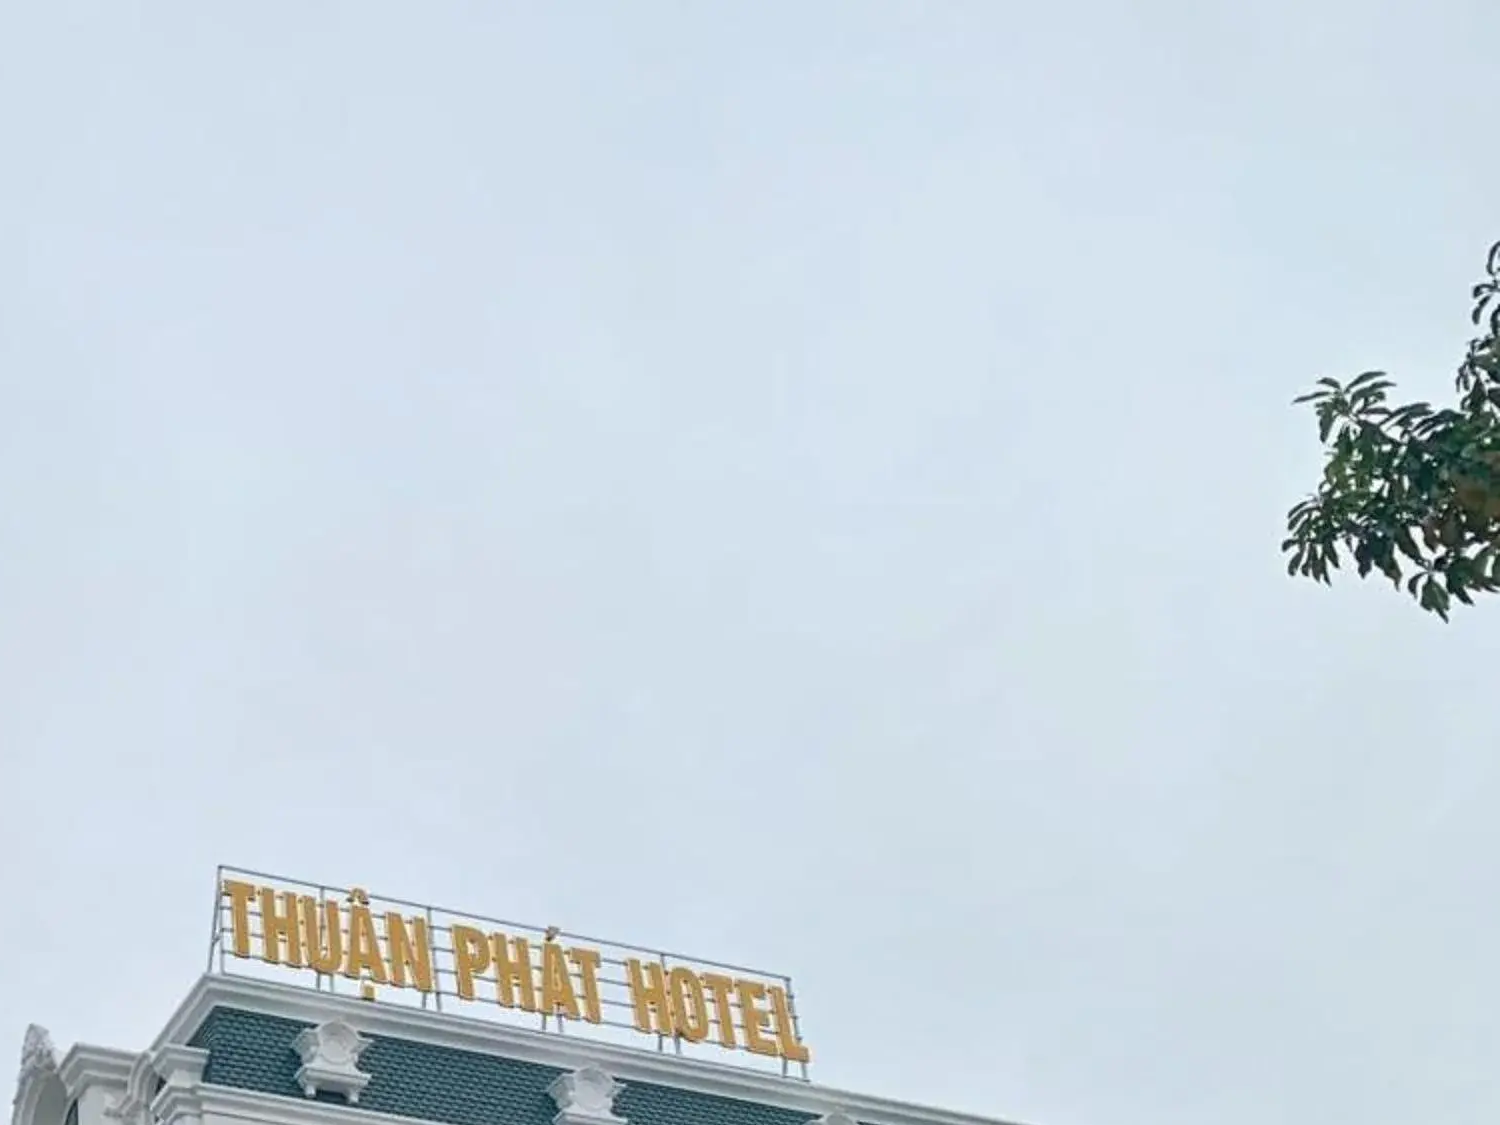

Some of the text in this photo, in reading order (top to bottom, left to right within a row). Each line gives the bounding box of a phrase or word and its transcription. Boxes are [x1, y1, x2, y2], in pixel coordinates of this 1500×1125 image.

[223, 879, 810, 1063] THUẬN PHÁT HOTEL
